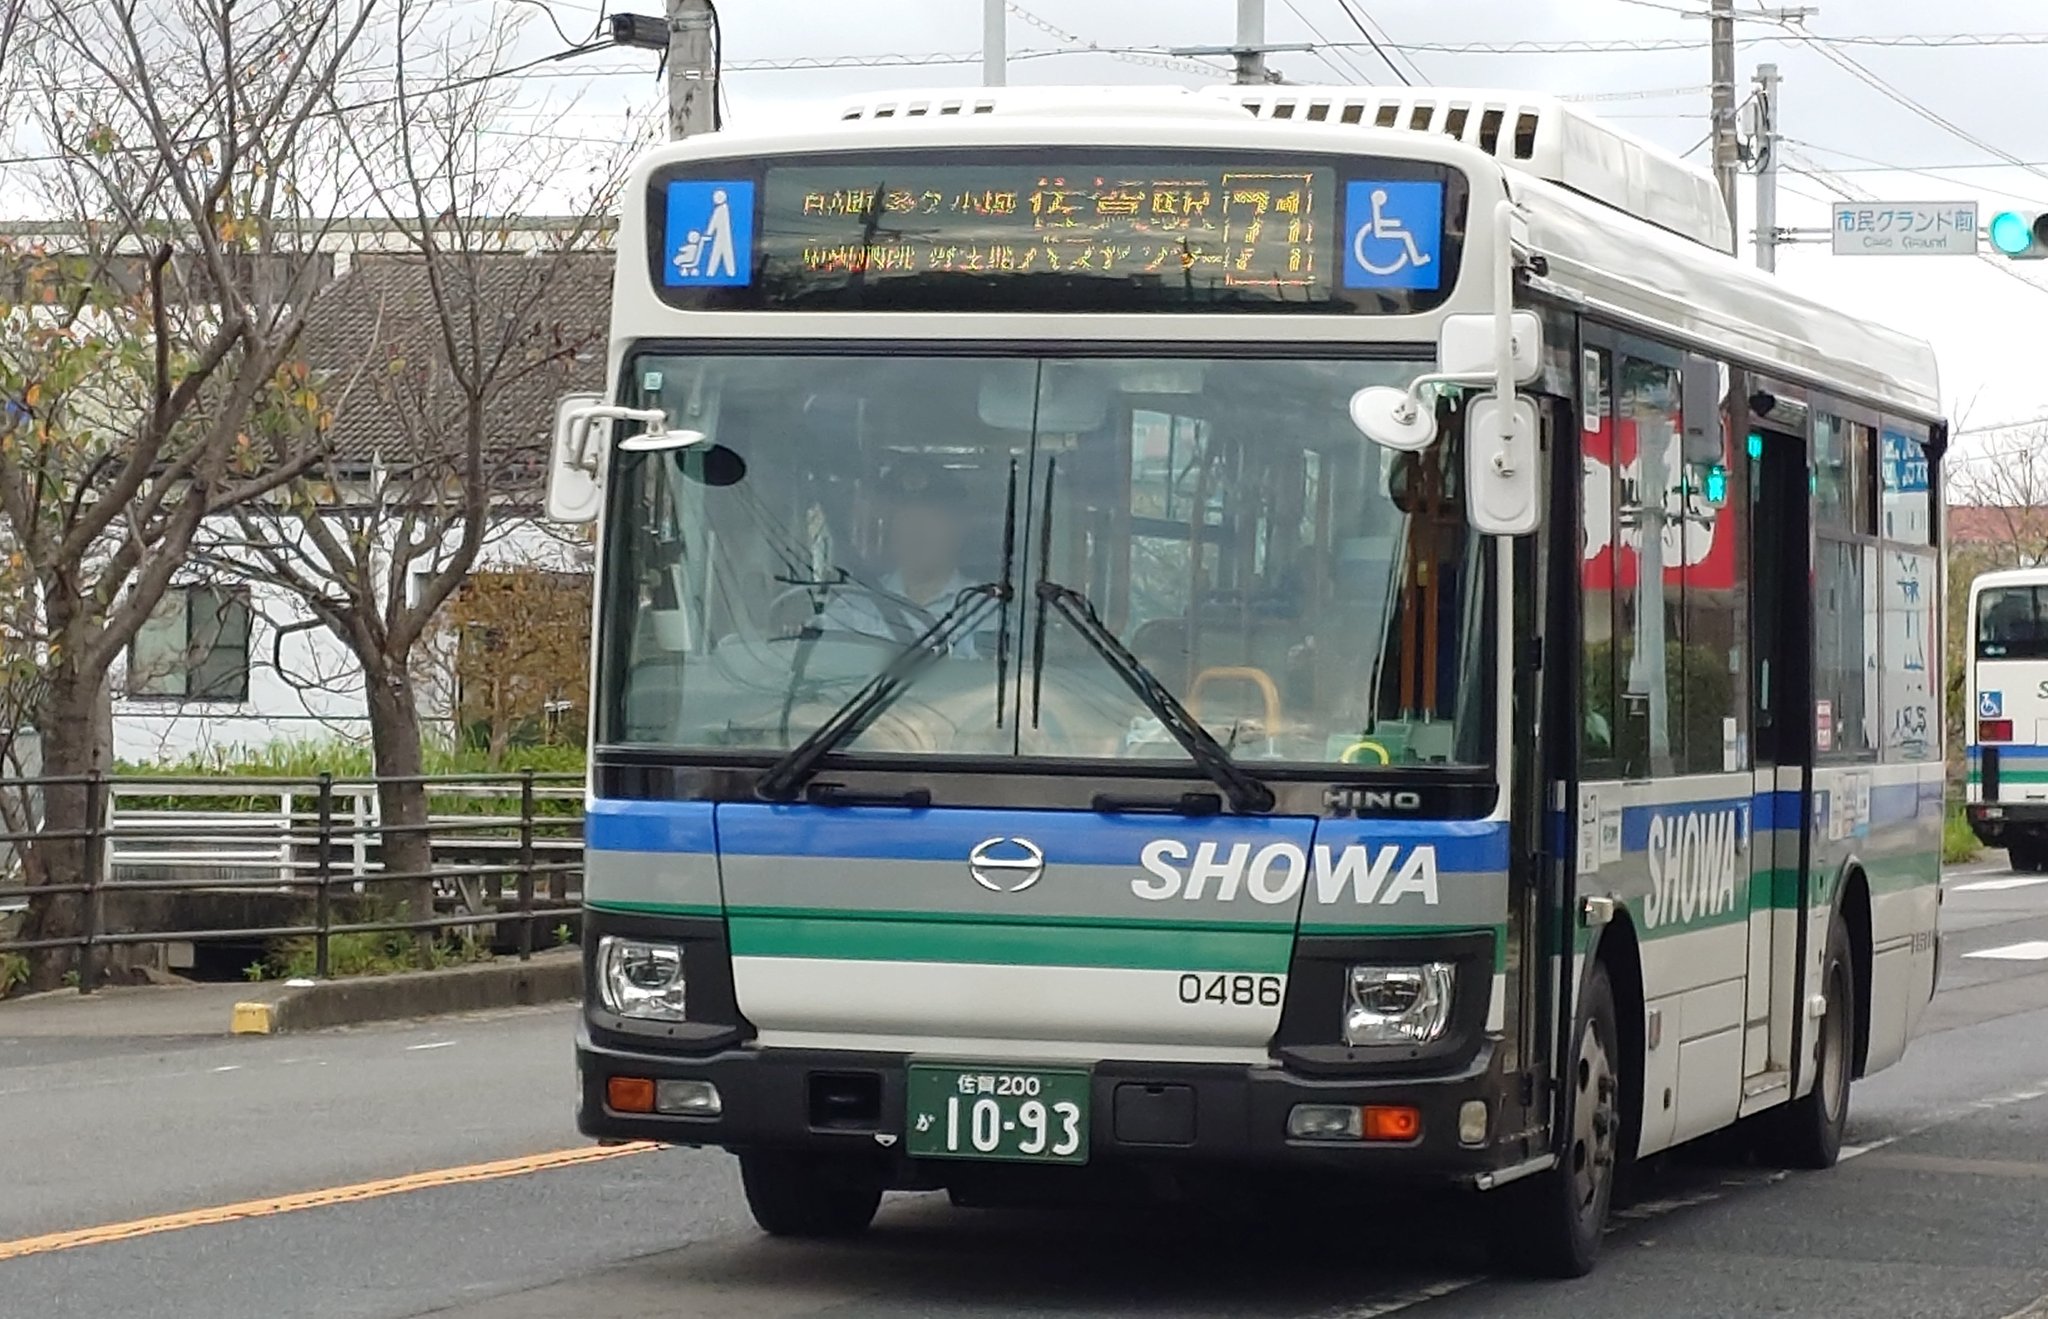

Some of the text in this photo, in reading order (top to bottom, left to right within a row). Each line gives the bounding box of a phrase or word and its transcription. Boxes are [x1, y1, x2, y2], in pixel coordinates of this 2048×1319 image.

[1836, 209, 1974, 232] 市民グランド前
[1322, 790, 1421, 810] HINO
[1131, 839, 1440, 905] SHOWA
[1644, 810, 1736, 930] SHOWA
[1178, 973, 1282, 1006] 0486
[947, 1096, 1080, 1156] 10-93
